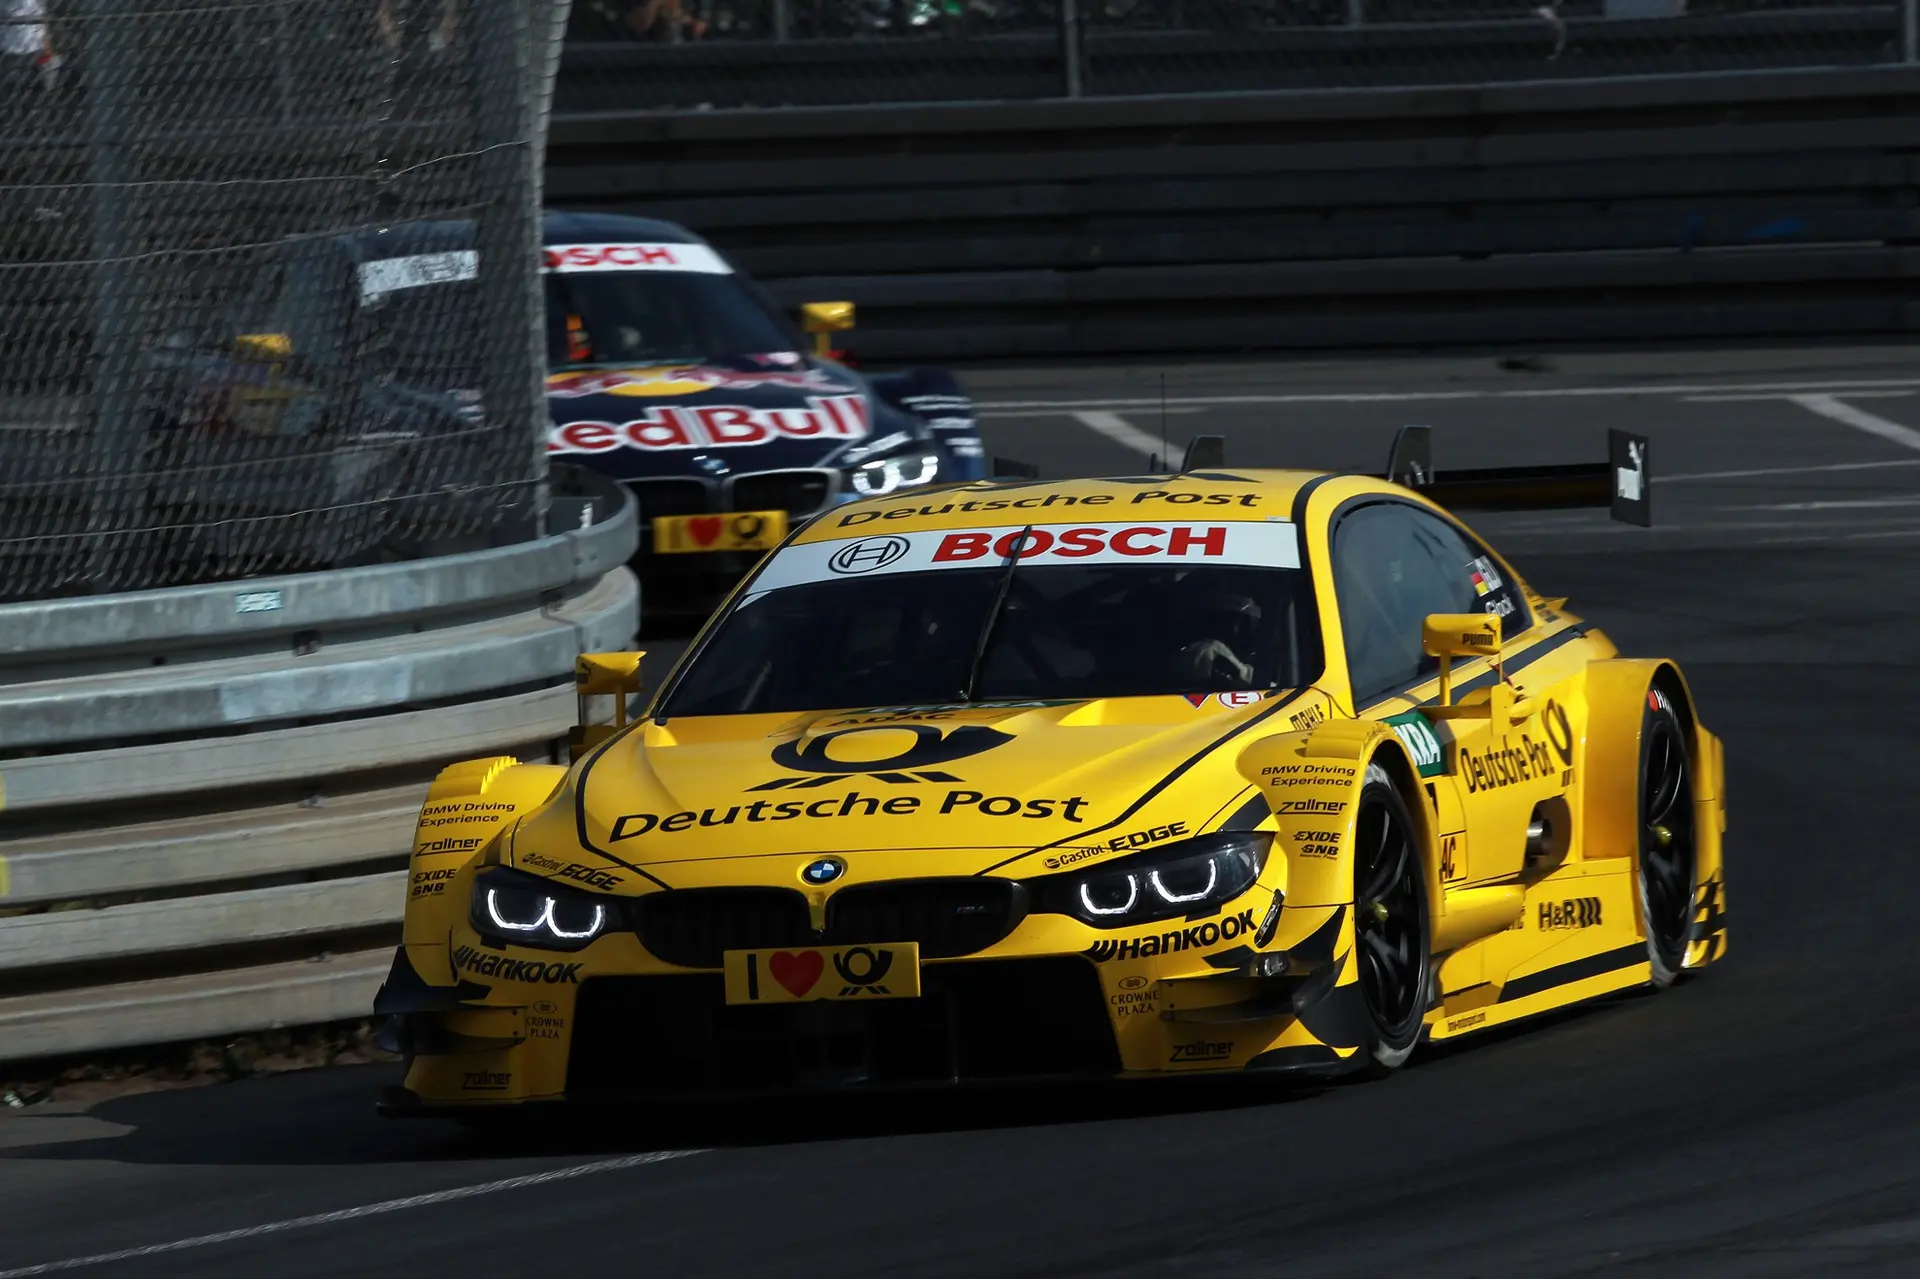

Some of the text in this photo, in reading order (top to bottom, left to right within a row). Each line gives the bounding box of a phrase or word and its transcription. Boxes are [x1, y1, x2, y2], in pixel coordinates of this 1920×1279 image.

[541, 408, 692, 452] ed
[837, 490, 1263, 528] Deutsche Post
[931, 527, 1227, 562] BOSCH
[1462, 633, 1494, 646] PUMA
[1261, 764, 1356, 777] BMW Driving
[1461, 735, 1530, 793] Deutsche
[1271, 777, 1353, 788] Experience
[423, 800, 516, 816] BMW Driving
[420, 813, 500, 828] Experience
[609, 790, 1089, 843] Deutsche Post
[1060, 821, 1190, 866] Castrol EDGE
[1293, 831, 1341, 843] EXIDE
[1301, 844, 1339, 857] GNB
[413, 868, 457, 884] EXIDE
[557, 863, 625, 891] EDGE
[1539, 901, 1576, 930] H&R
[747, 954, 759, 999] I
[1110, 989, 1160, 1006] CROWNE
[1117, 1004, 1155, 1017] PLAZA
[526, 1016, 565, 1028] CROWNE
[531, 1027, 560, 1039] PLAZA
